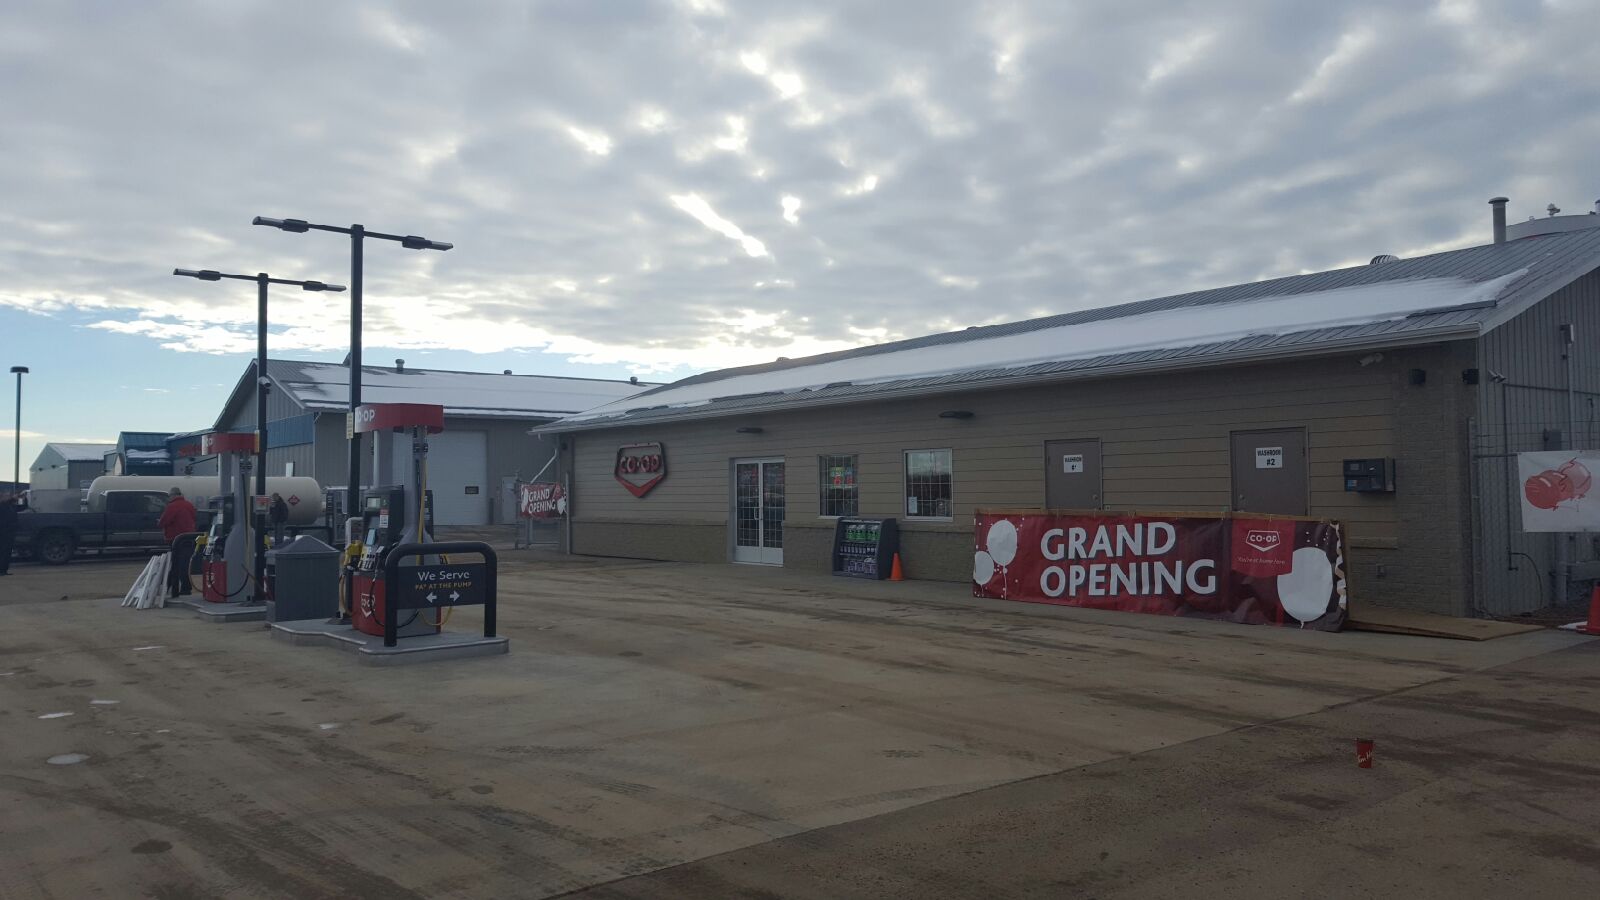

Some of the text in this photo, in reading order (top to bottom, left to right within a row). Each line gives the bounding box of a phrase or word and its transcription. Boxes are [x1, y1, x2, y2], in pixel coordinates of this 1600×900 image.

[620, 454, 660, 473] CO-OP
[1266, 458, 1276, 466] #2
[528, 488, 551, 502] GRAND
[528, 498, 556, 514] OPENING
[1040, 521, 1177, 561] GRAND
[1249, 534, 1278, 543] CO-OP
[417, 570, 470, 581] We Serve
[1039, 558, 1217, 598] OPENING
